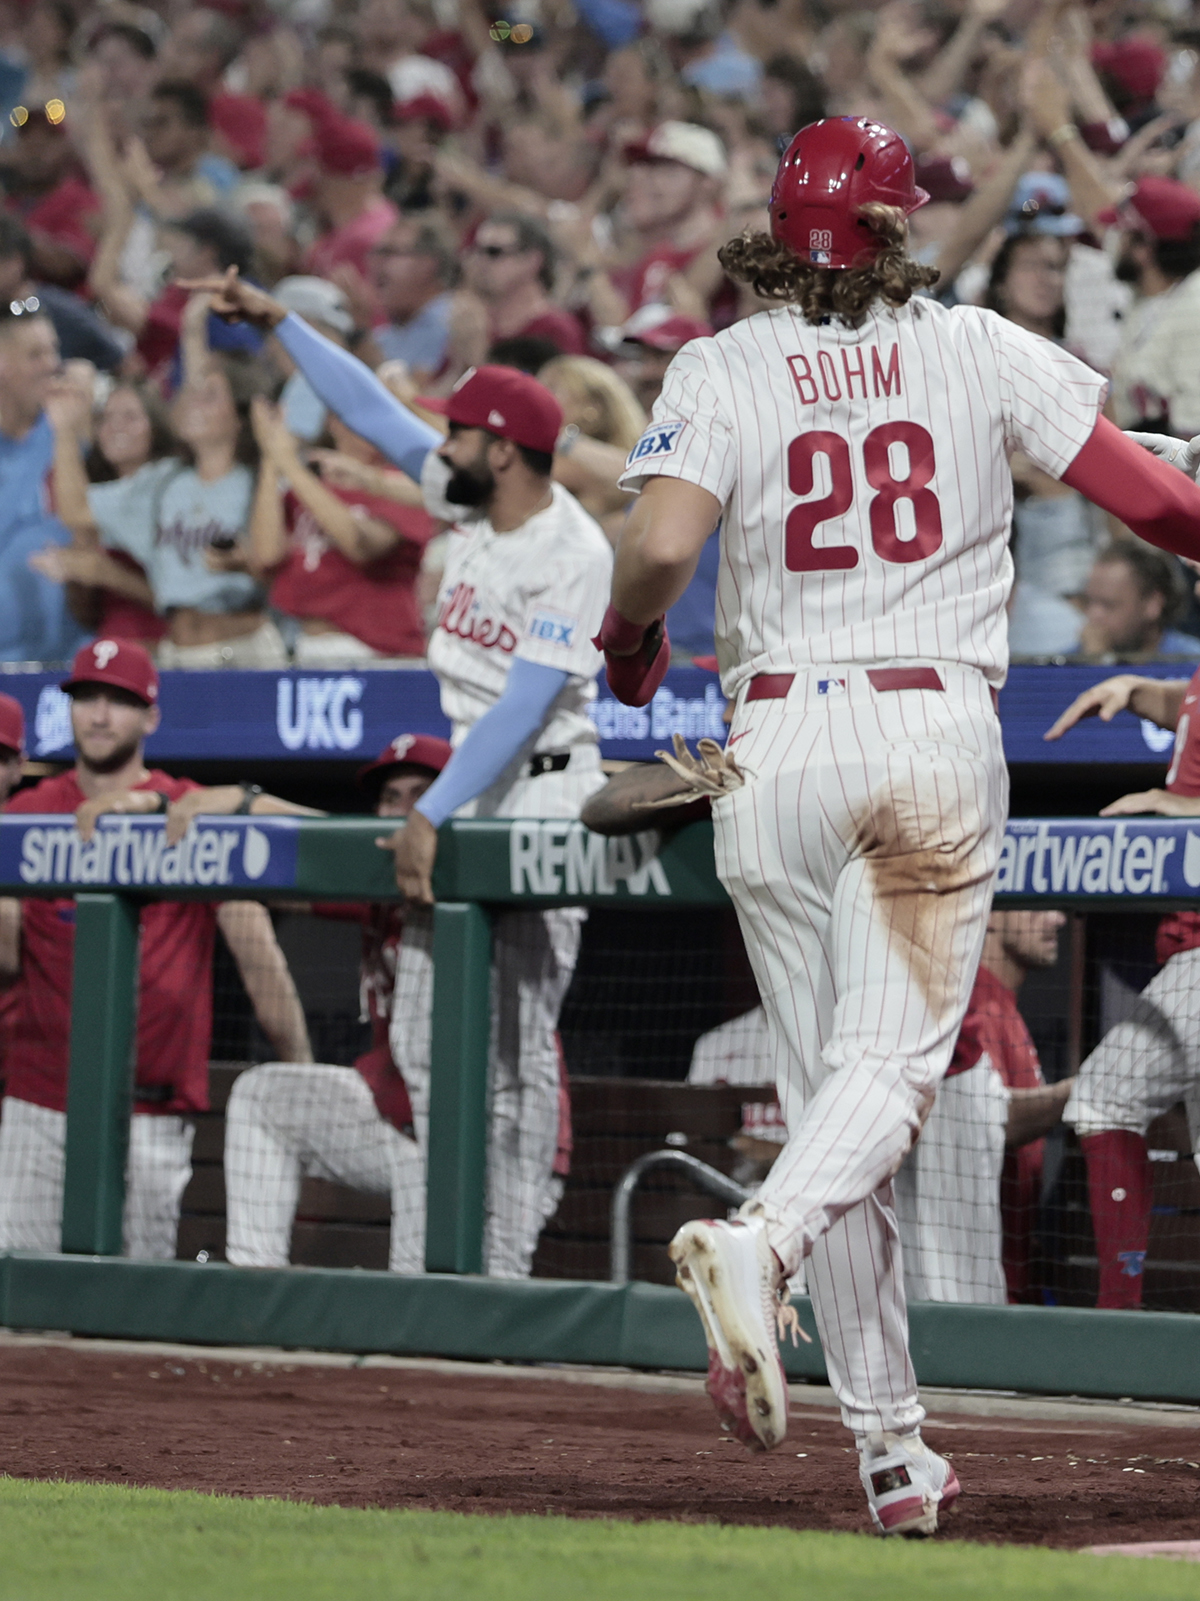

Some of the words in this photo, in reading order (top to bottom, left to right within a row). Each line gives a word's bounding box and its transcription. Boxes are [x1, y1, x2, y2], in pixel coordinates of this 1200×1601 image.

[810, 229, 832, 250] 28
[786, 342, 902, 406] BOHM
[628, 430, 679, 465] IBX
[784, 420, 944, 573] 28
[438, 583, 518, 653] illies
[530, 618, 573, 648] IBX
[276, 677, 364, 750] UKG
[19, 818, 240, 885] smartwater
[993, 822, 1176, 893] artwater
